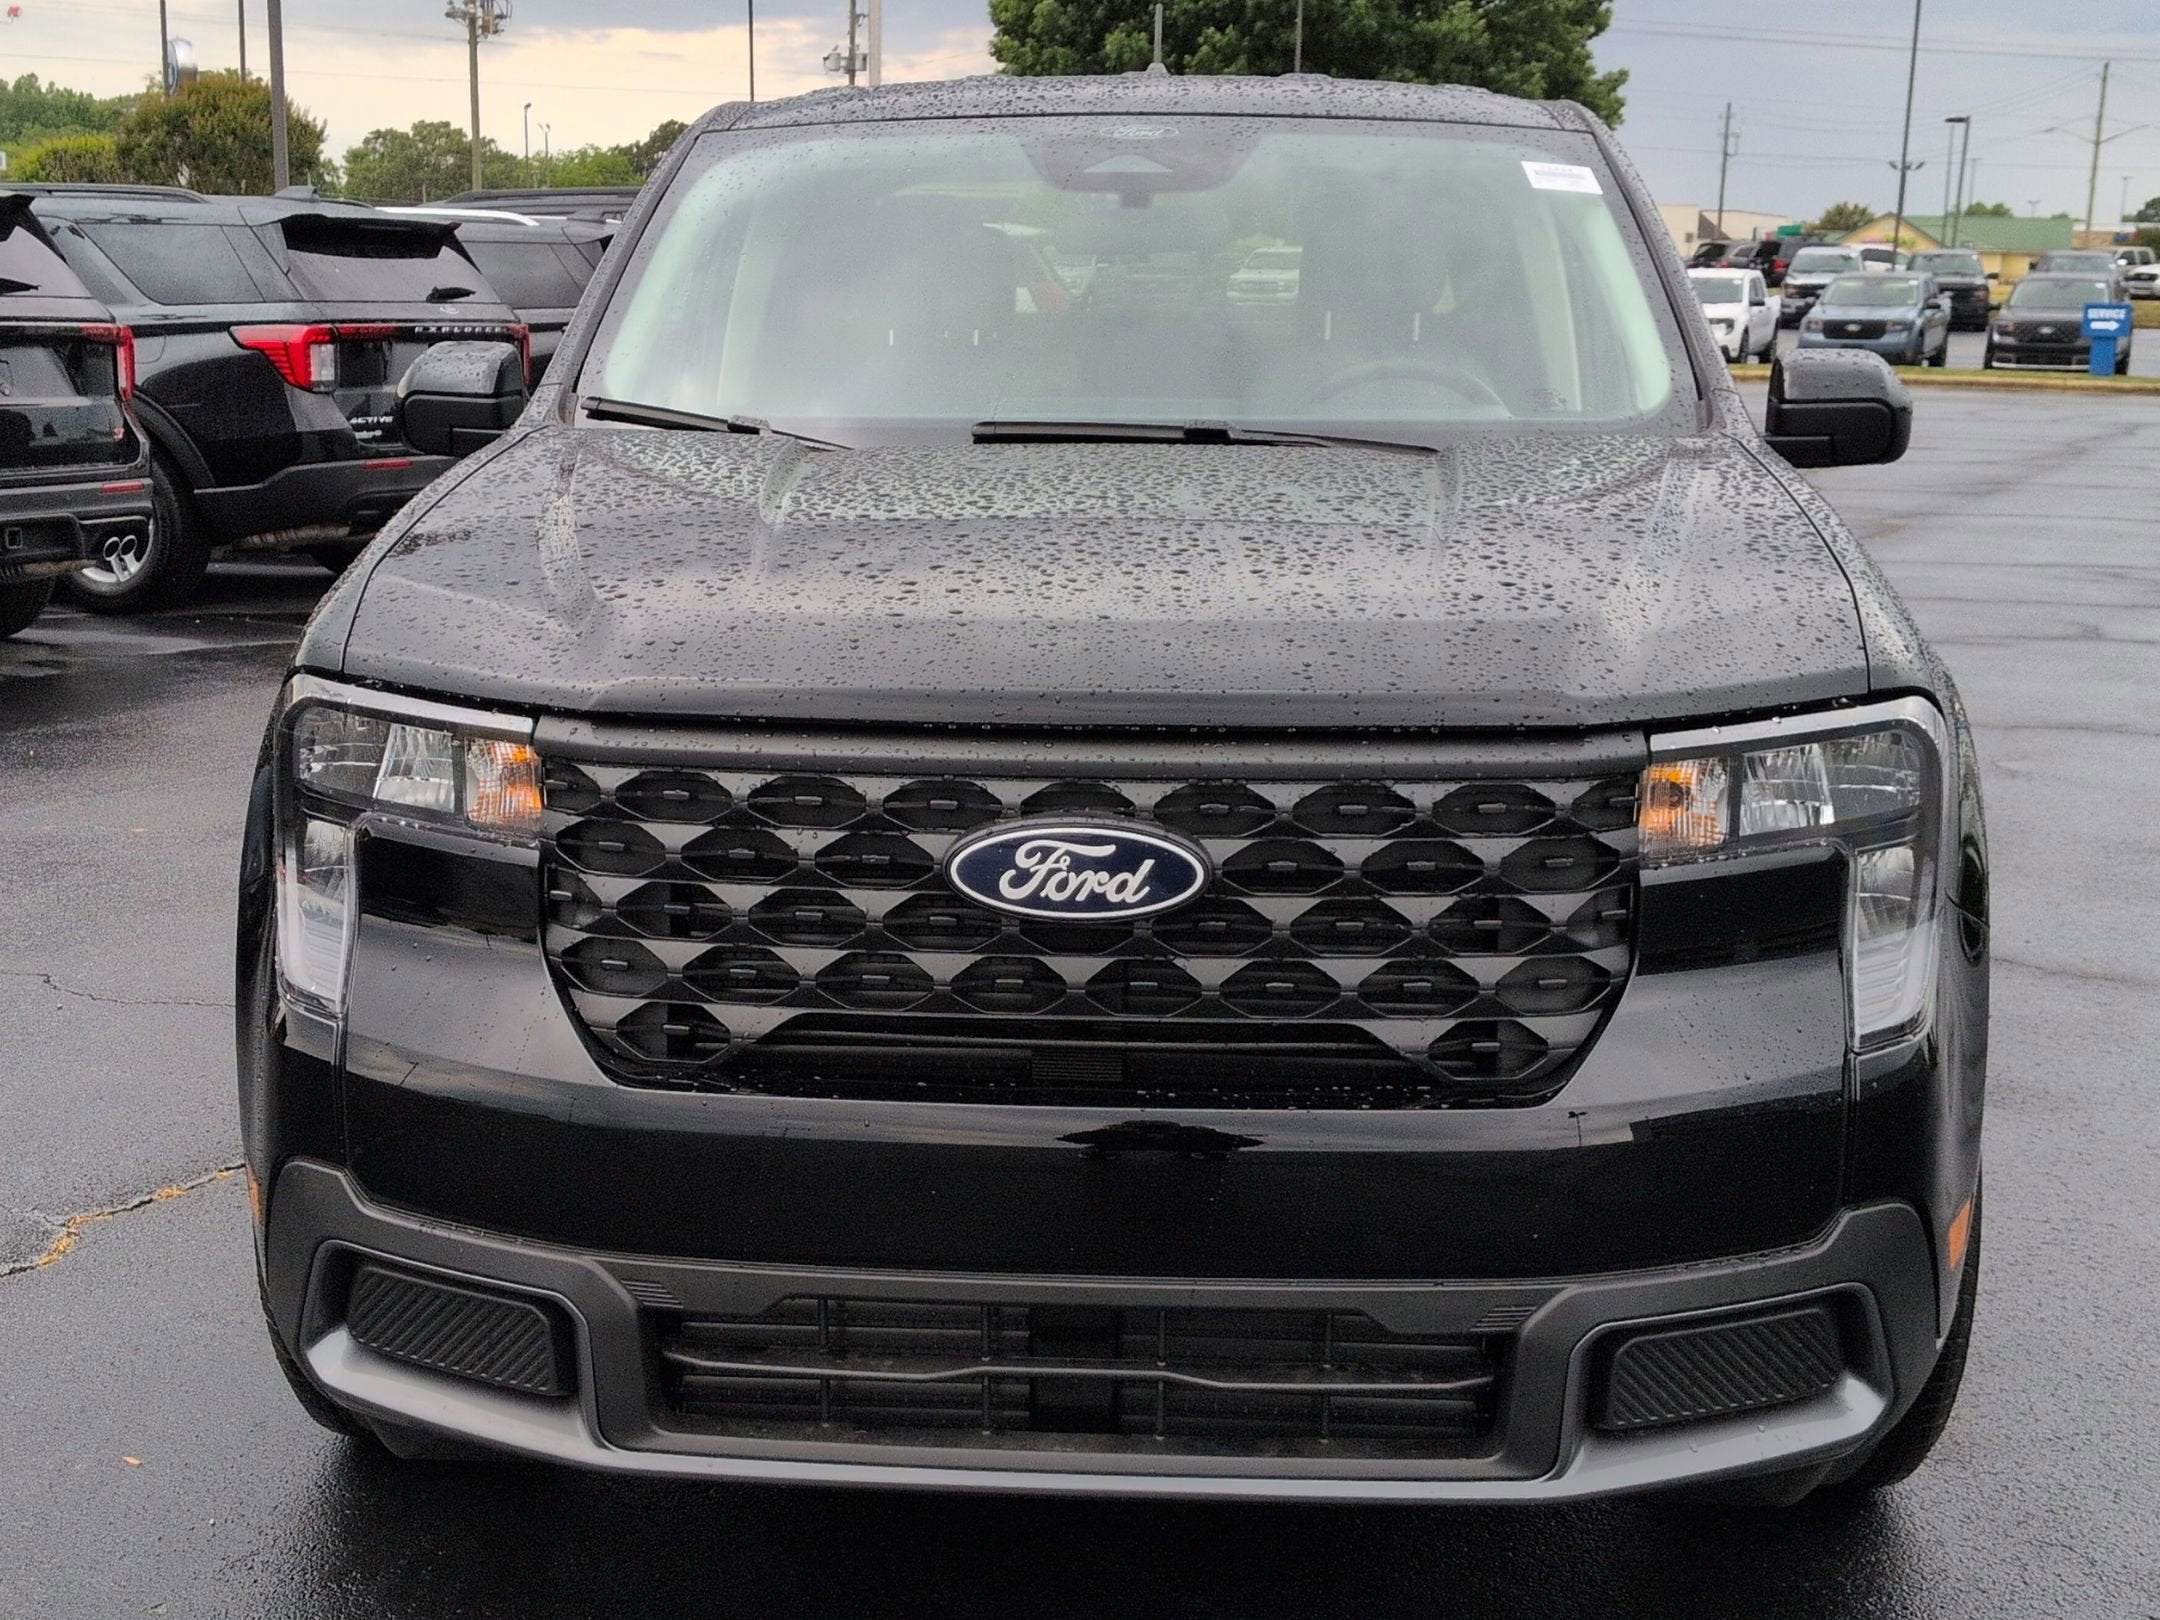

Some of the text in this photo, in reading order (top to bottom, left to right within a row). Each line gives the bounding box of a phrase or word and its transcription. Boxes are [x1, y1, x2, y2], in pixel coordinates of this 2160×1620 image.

[1113, 127, 1165, 138] Ford
[2088, 308, 2126, 319] SERVICE
[414, 325, 502, 334] EXPLORER
[349, 415, 394, 424] ACTIVE
[998, 839, 1155, 903] Ford
